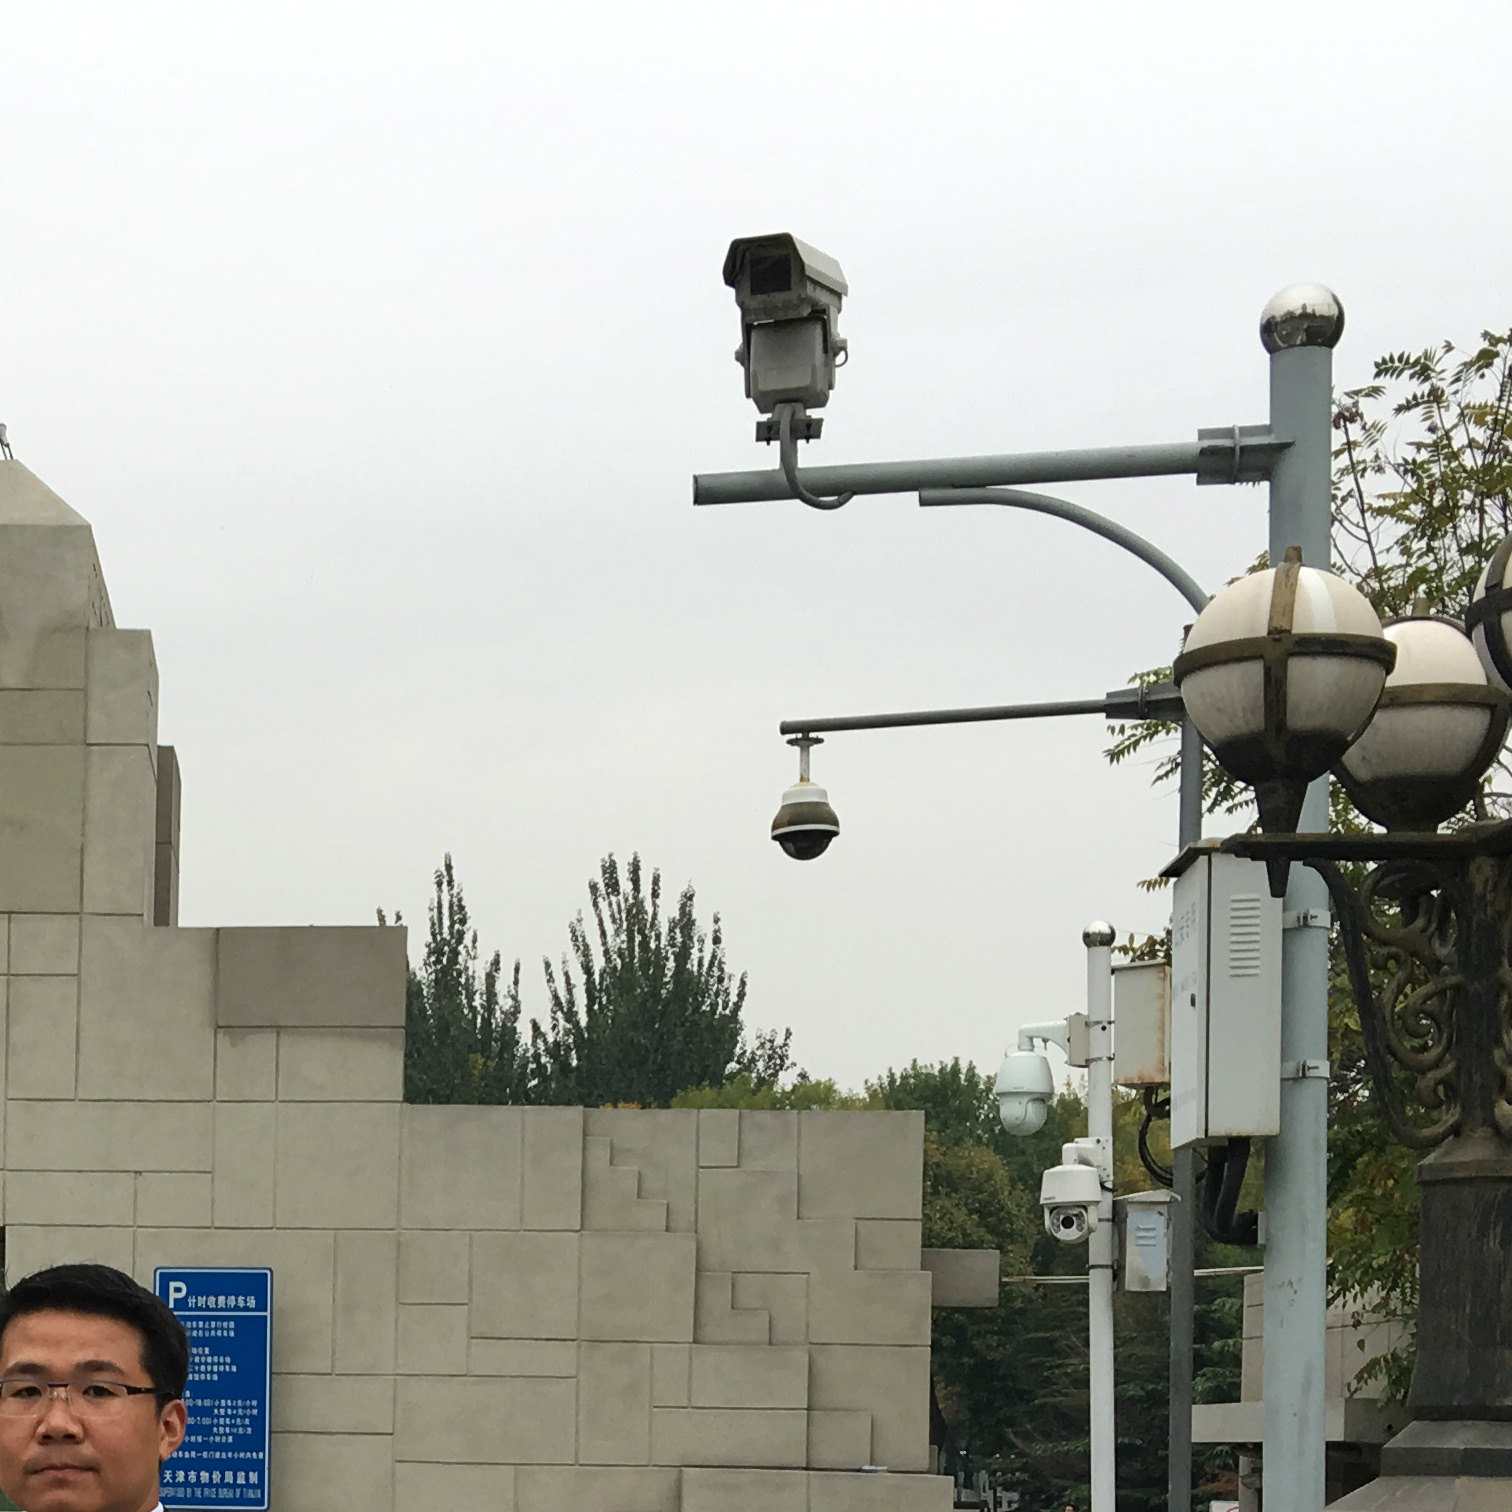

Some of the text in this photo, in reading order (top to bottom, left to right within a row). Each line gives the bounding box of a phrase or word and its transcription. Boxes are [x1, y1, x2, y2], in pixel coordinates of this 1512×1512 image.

[168, 1281, 187, 1309] P
[187, 1295, 256, 1309] 计时收费停车场
[163, 1470, 259, 1485] 天津市物价局监制
